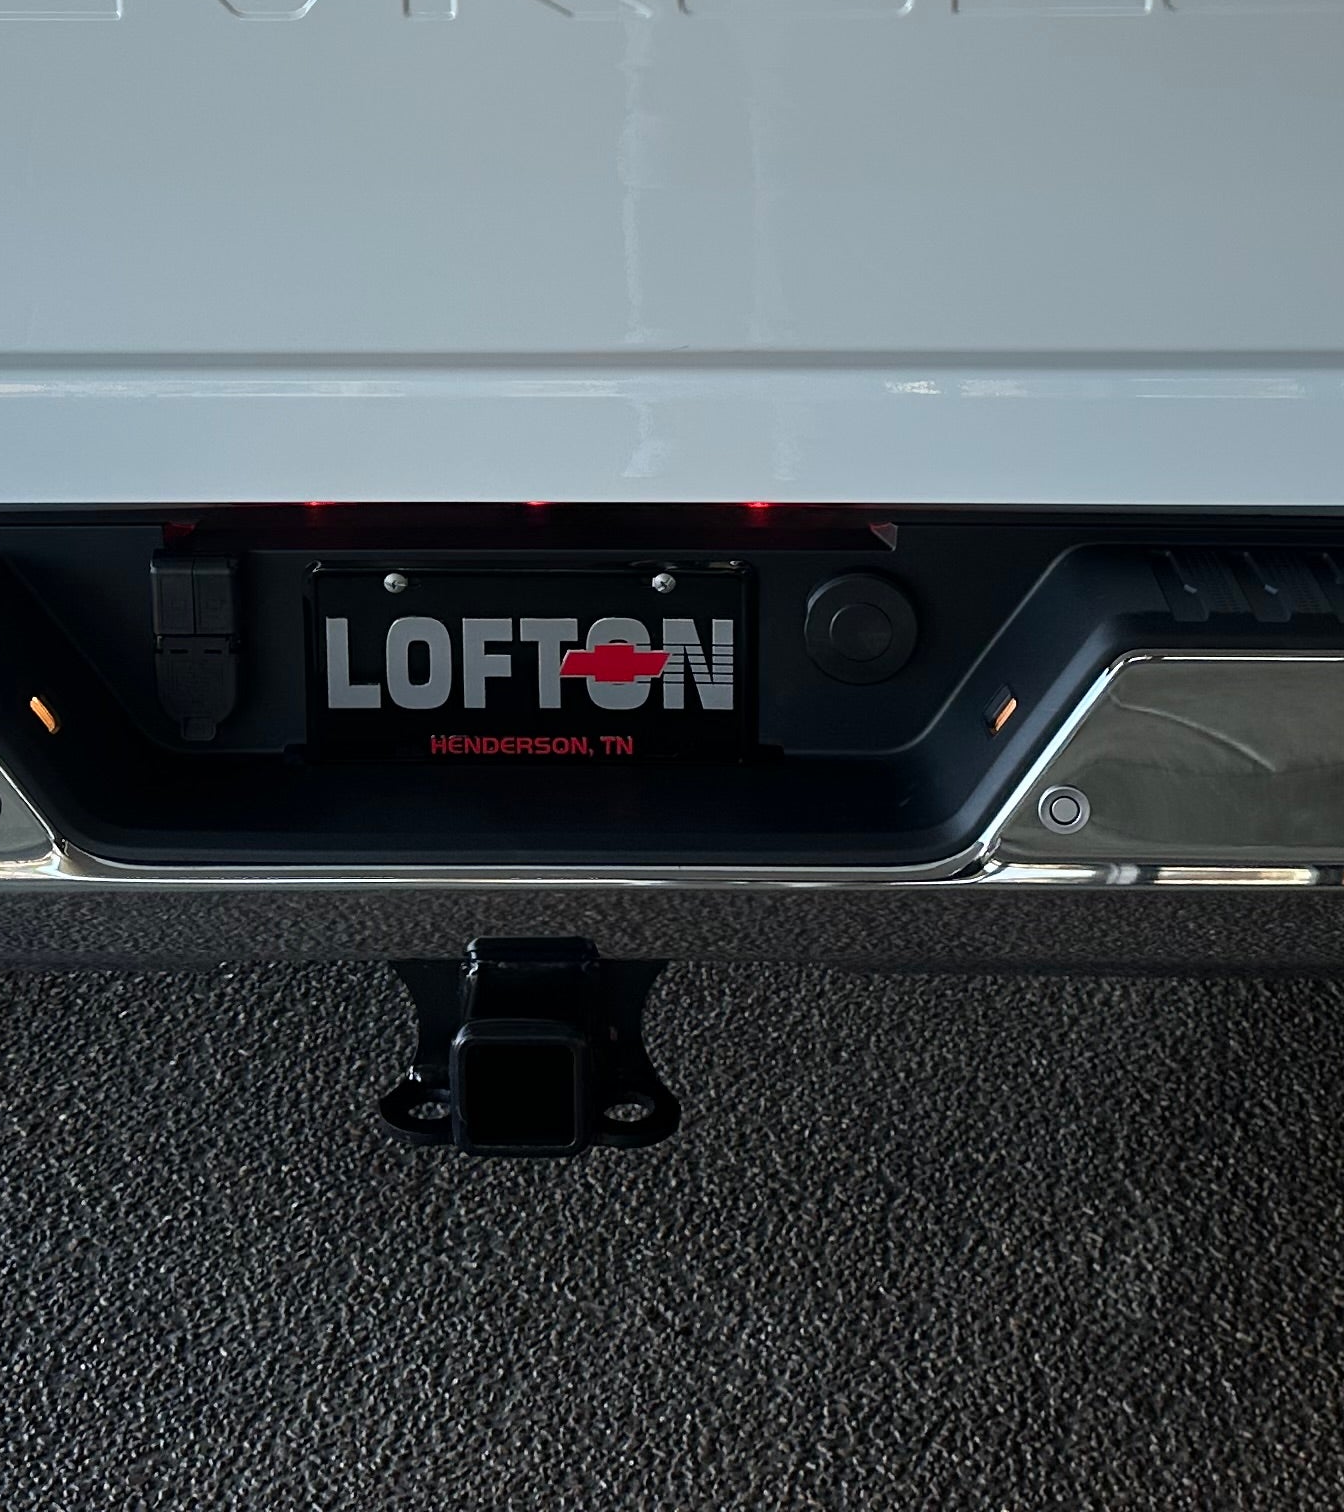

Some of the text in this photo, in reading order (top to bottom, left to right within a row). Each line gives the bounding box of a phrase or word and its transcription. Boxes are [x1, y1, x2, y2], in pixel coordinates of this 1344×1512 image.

[325, 616, 735, 710] LOFTON
[430, 734, 634, 756] HENDERSON, TN
